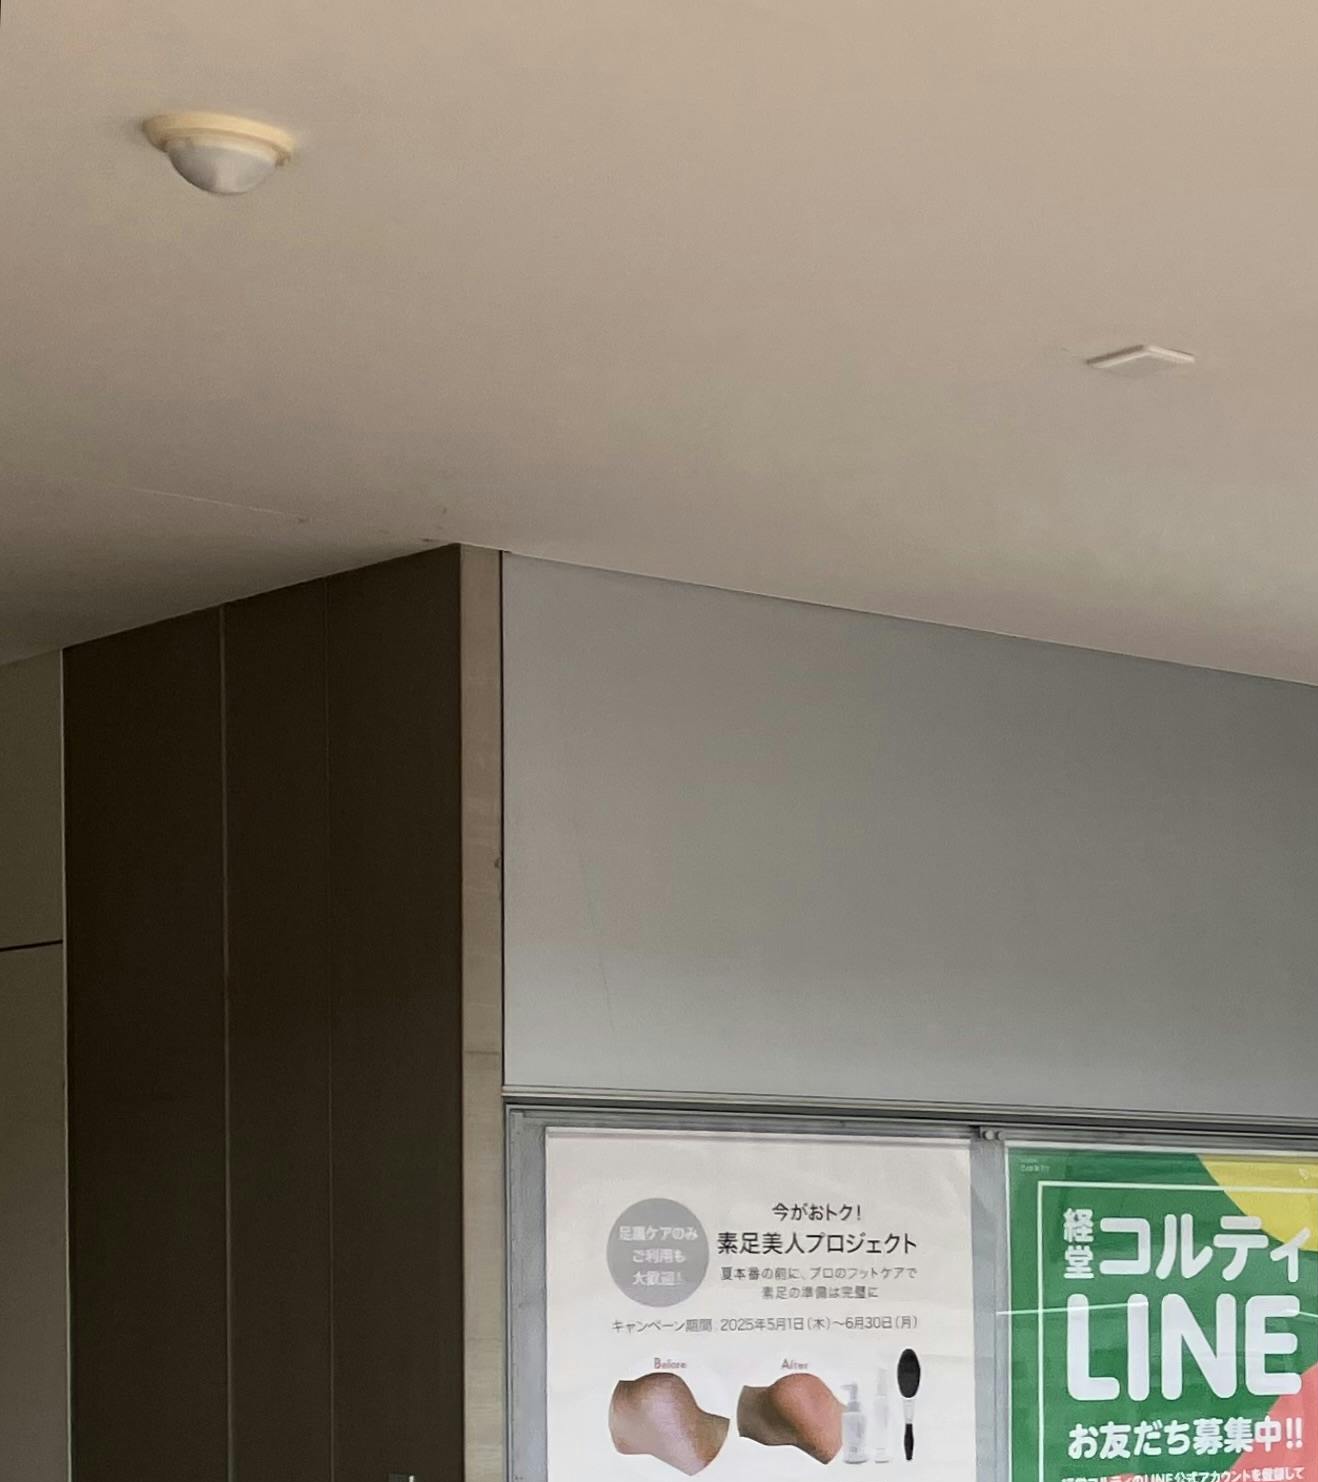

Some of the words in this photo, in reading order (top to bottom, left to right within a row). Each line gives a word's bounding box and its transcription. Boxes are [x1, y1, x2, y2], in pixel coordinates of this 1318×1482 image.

[772, 1203, 861, 1222] 今がおトク！
[717, 1232, 917, 1255] 素足美人プロジェクト
[632, 1248, 685, 1264] ご利用も
[612, 1318, 712, 1334] キャンペーン期間
[1067, 1294, 1302, 1401] LINE
